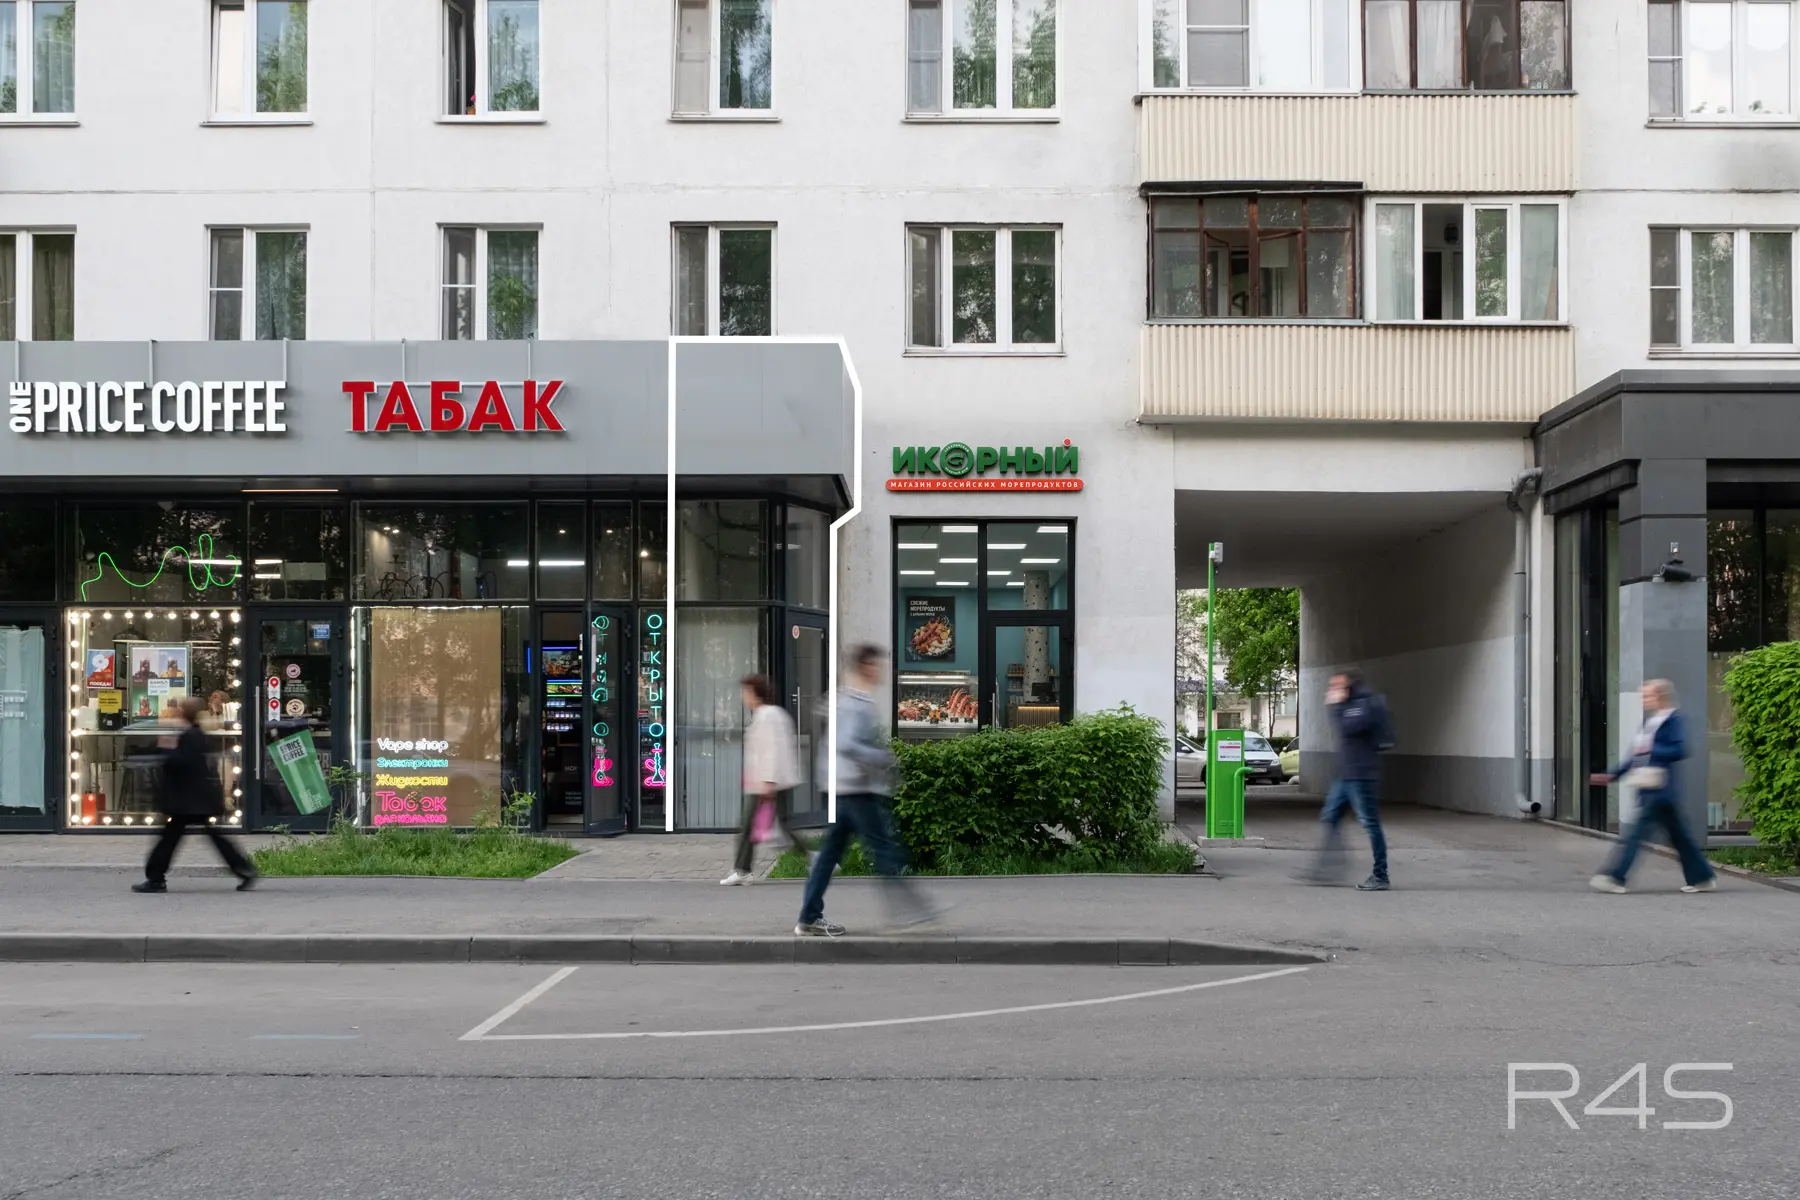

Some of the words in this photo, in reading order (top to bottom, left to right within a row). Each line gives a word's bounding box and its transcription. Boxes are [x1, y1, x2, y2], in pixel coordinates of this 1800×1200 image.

[10, 381, 33, 433] ONE
[35, 381, 145, 433] PRICE
[152, 381, 287, 433] COFFEE
[342, 380, 565, 432] ТАБАК
[893, 438, 1079, 476] ИКОРНЫЙ
[936, 480, 996, 488] РОССИЙСКИХ
[1000, 481, 1078, 489] МОРЕПРОДУКТОВ
[647, 614, 664, 737] ОТКРЫТО
[377, 738, 413, 753] Vape
[415, 738, 448, 753] shop
[377, 757, 448, 770] Электронки
[376, 774, 448, 789] Жидкости
[375, 791, 447, 812] Табак
